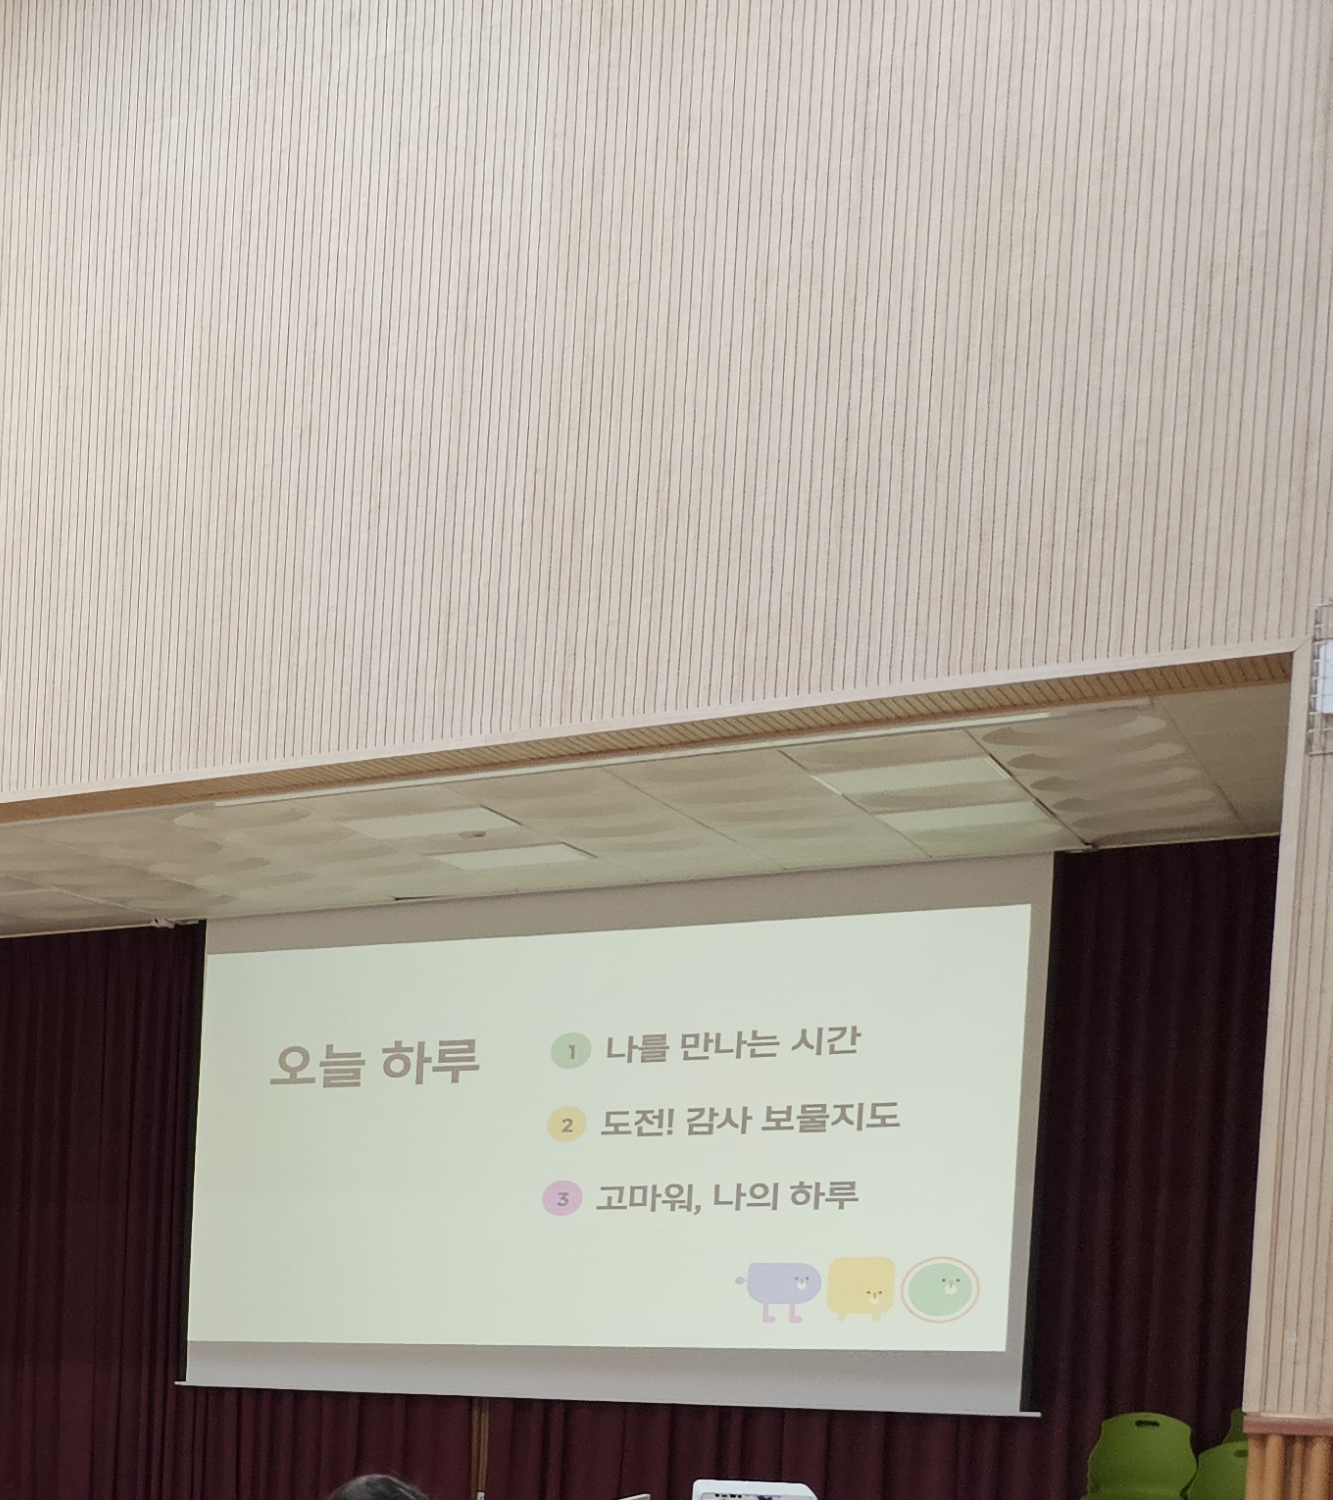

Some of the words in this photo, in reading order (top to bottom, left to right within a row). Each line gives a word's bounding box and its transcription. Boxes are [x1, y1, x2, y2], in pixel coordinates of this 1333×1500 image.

[567, 1043, 576, 1060] 1
[605, 1032, 670, 1063] 나를
[680, 1029, 780, 1061] 만나는
[790, 1025, 862, 1056] 시간
[269, 1044, 366, 1088] 오늘
[381, 1038, 480, 1085] 하루
[561, 1118, 574, 1133] 2
[600, 1107, 675, 1138] 도전!
[685, 1105, 753, 1135] 감사
[760, 1101, 901, 1134] 보물지도
[556, 1191, 570, 1207] 3
[595, 1183, 702, 1216] 고마워,
[713, 1182, 779, 1212] 나의
[789, 1180, 860, 1211] 하루
